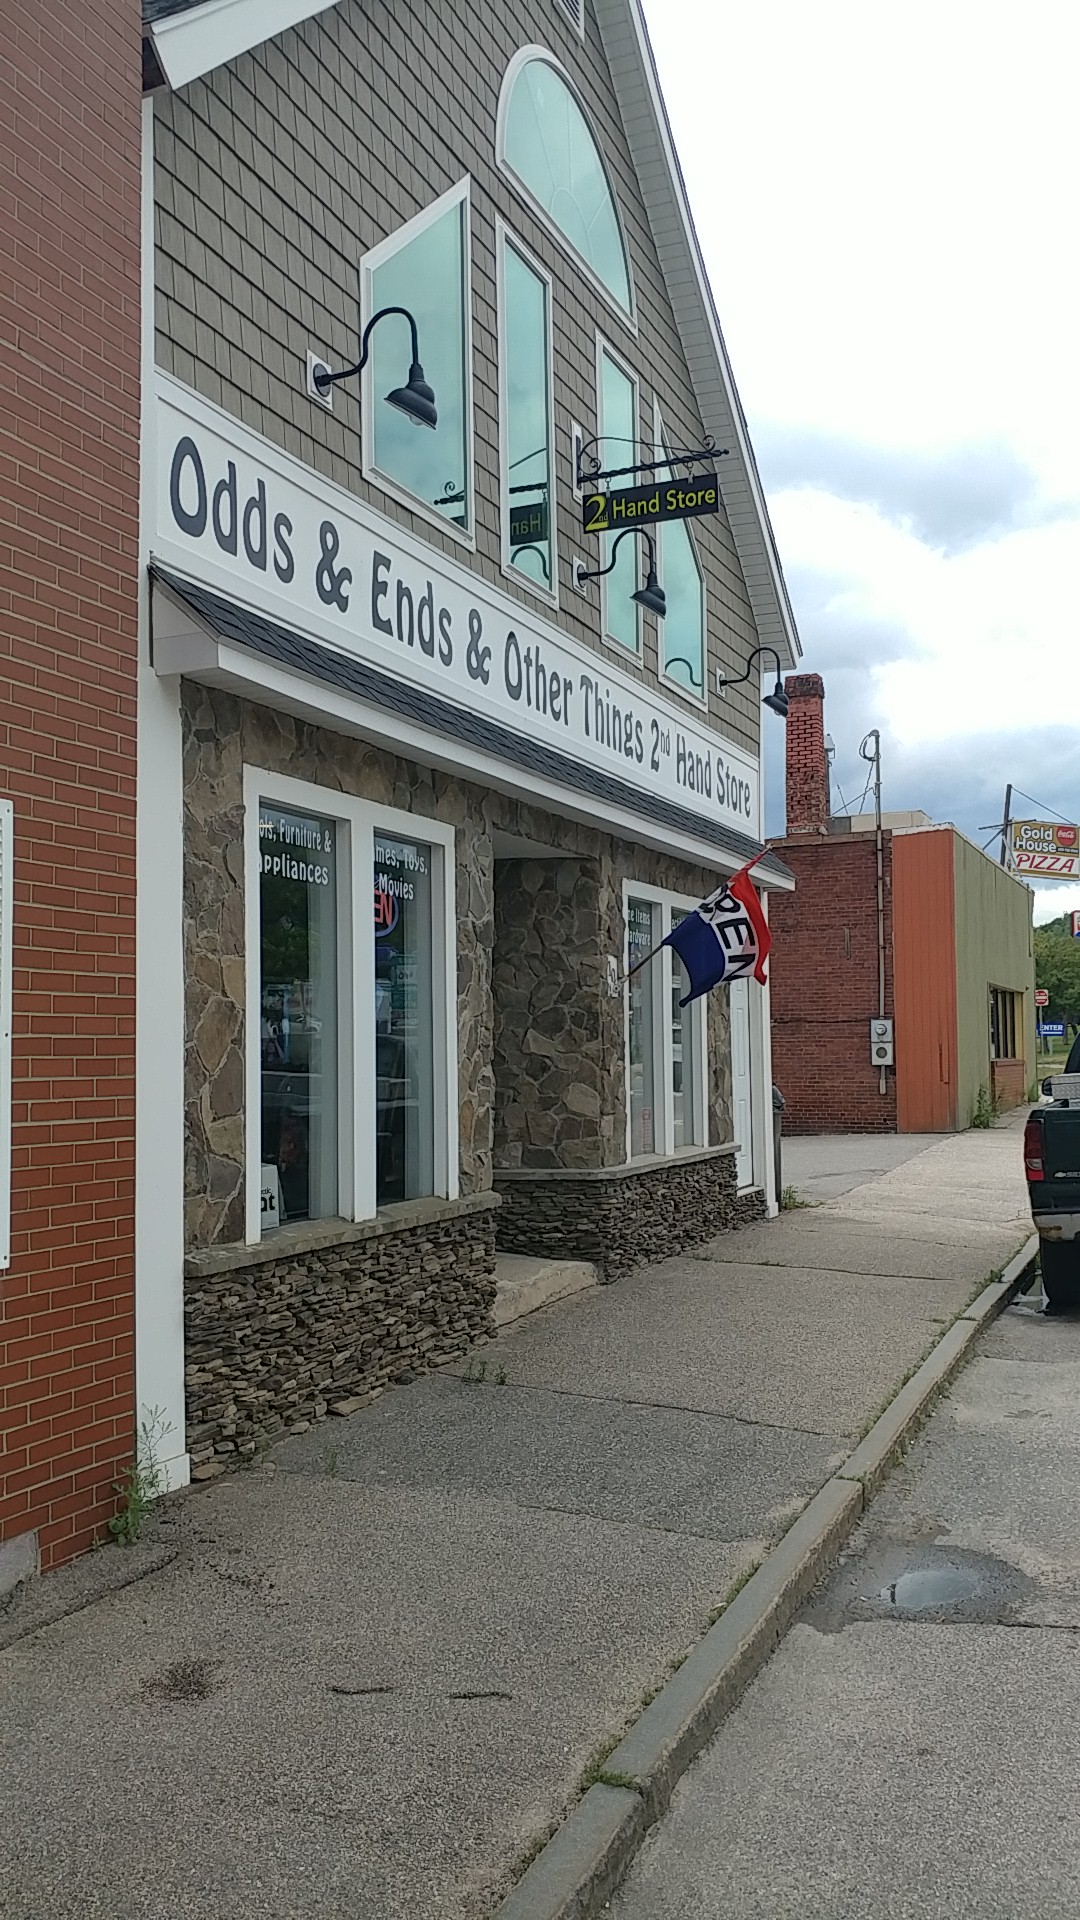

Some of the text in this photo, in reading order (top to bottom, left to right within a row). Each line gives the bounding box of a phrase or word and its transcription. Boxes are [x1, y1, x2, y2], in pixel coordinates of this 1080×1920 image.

[585, 489, 716, 531] 2nd Hand Store
[170, 436, 750, 818] Odds & Ends & Other Things 2nd Hand Store
[280, 818, 321, 851] Furniture
[324, 829, 332, 853] &
[1015, 836, 1057, 853] House
[1020, 825, 1053, 841] Gold
[403, 848, 428, 875] Toys,
[1016, 853, 1075, 872] PIZZA
[378, 872, 414, 900] Movies
